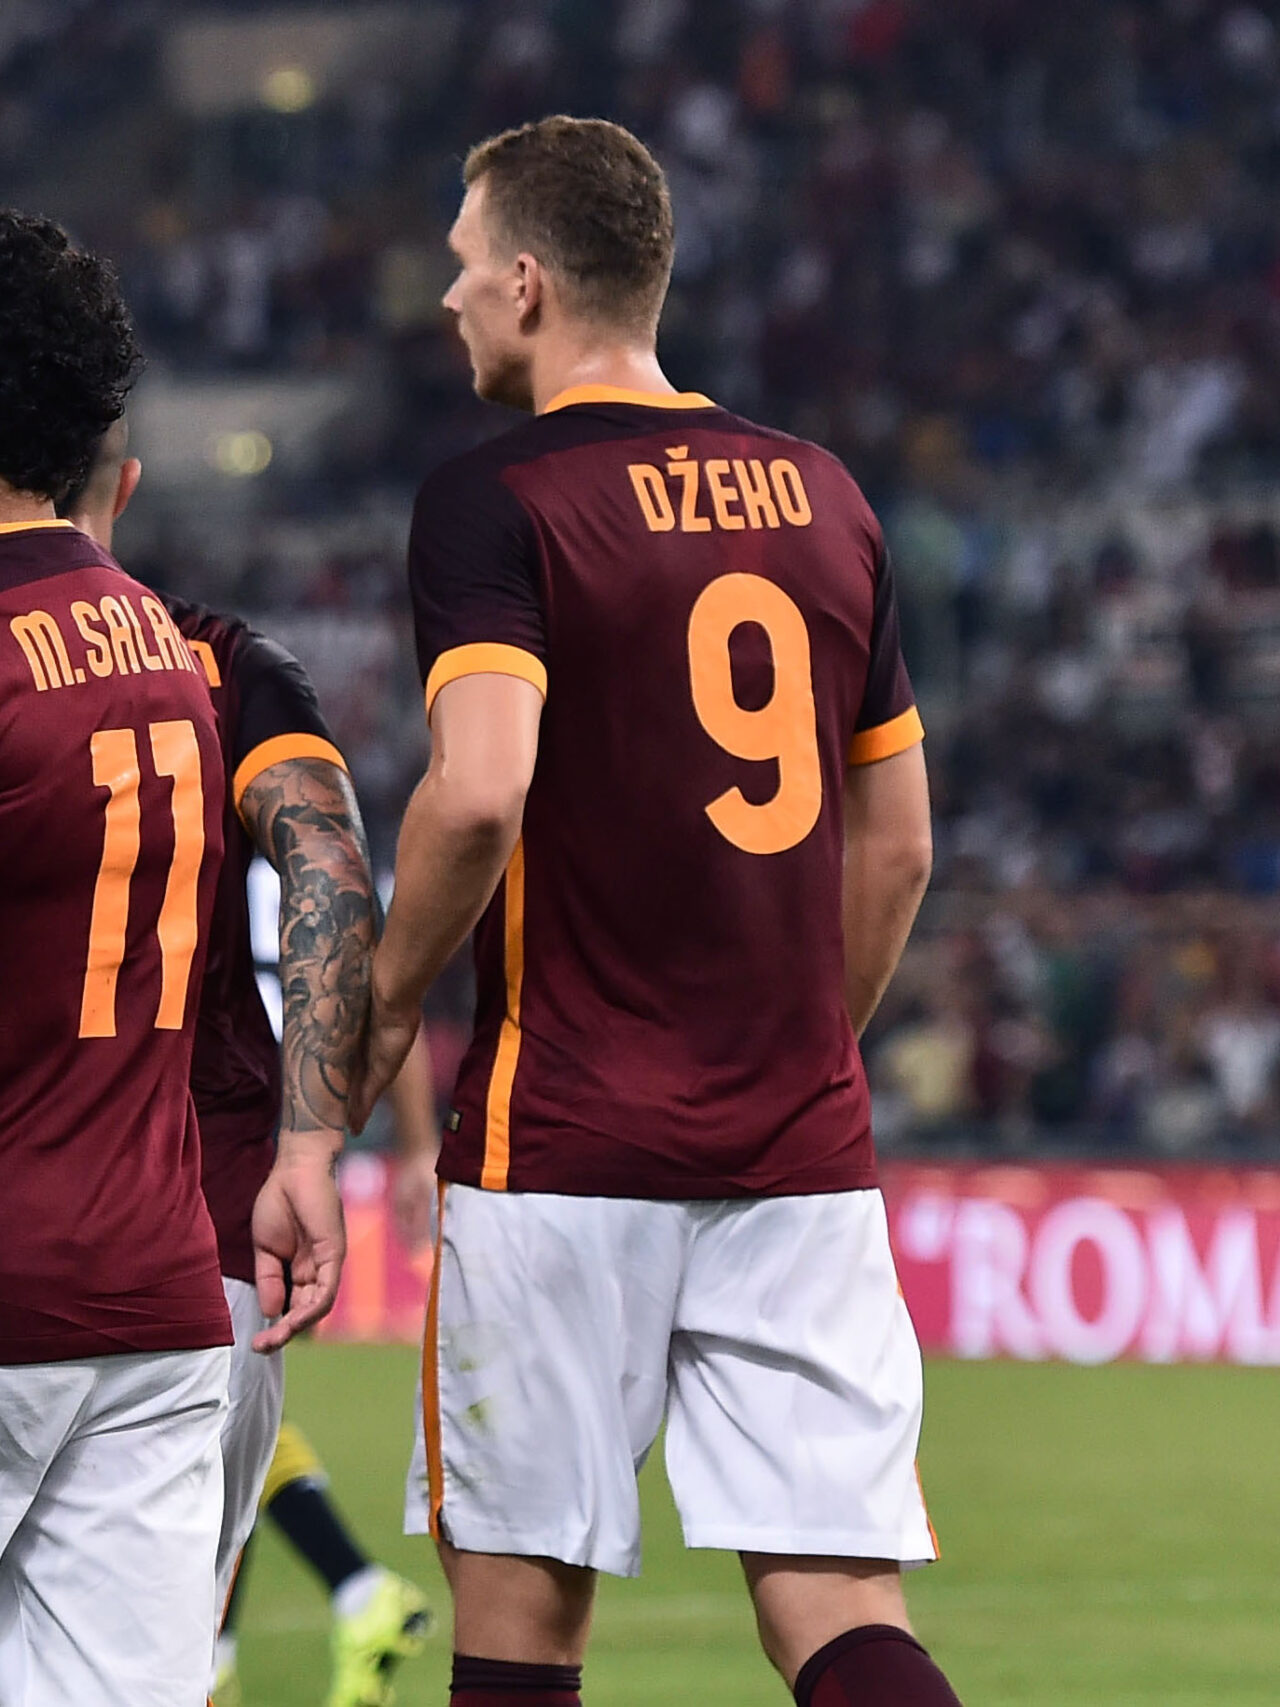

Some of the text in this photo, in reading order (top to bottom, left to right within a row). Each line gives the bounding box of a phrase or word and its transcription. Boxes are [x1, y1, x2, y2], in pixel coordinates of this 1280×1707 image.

[627, 445, 812, 532] DŽEKO
[688, 572, 822, 855] 9
[78, 719, 205, 1038] 11
